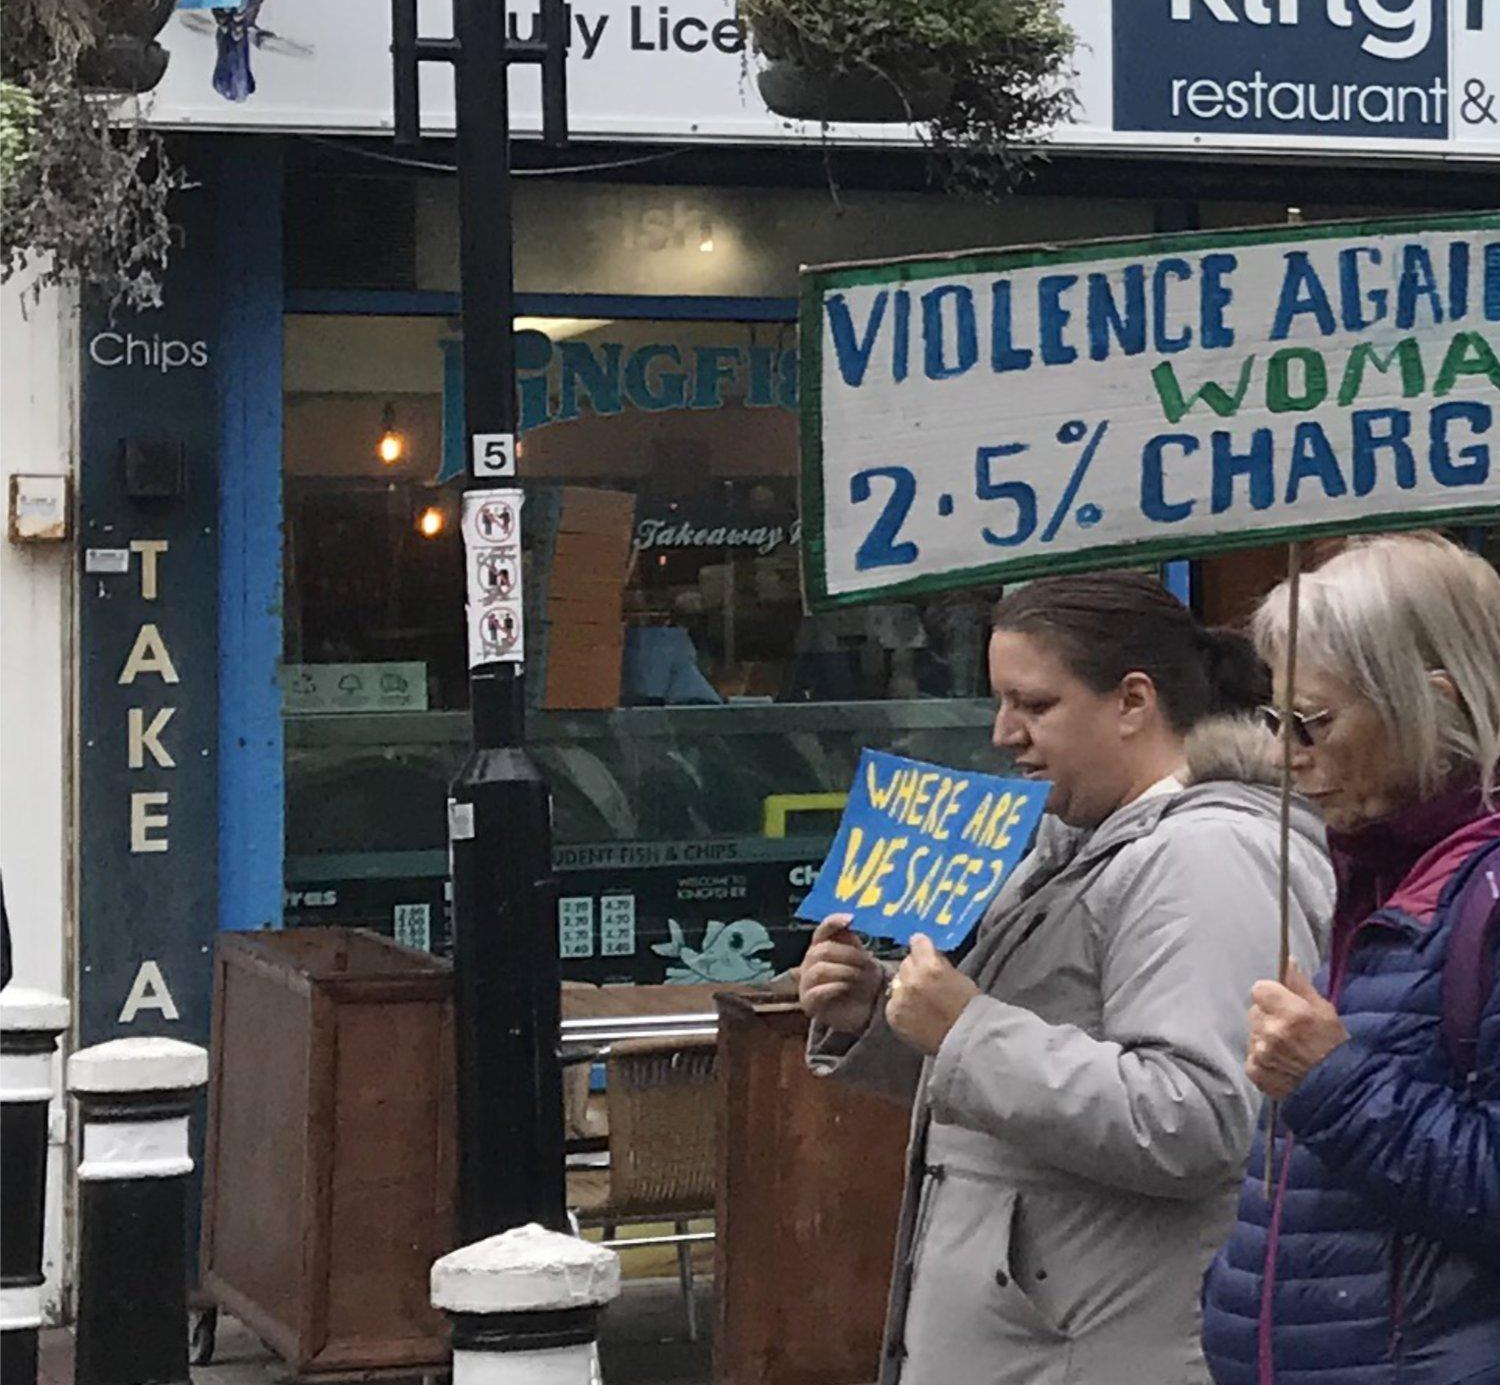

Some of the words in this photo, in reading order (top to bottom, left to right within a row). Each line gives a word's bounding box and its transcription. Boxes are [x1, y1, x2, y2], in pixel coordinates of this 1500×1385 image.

[1171, 71, 1448, 126] restaurant
[1460, 78, 1497, 126] &
[826, 252, 1239, 388] VIOLENCE
[90, 331, 208, 373] Chips
[482, 440, 507, 470] 5
[633, 519, 789, 554] Takeaway
[867, 762, 969, 840] WHERE
[961, 791, 1029, 850] ARE
[835, 827, 909, 909] WE
